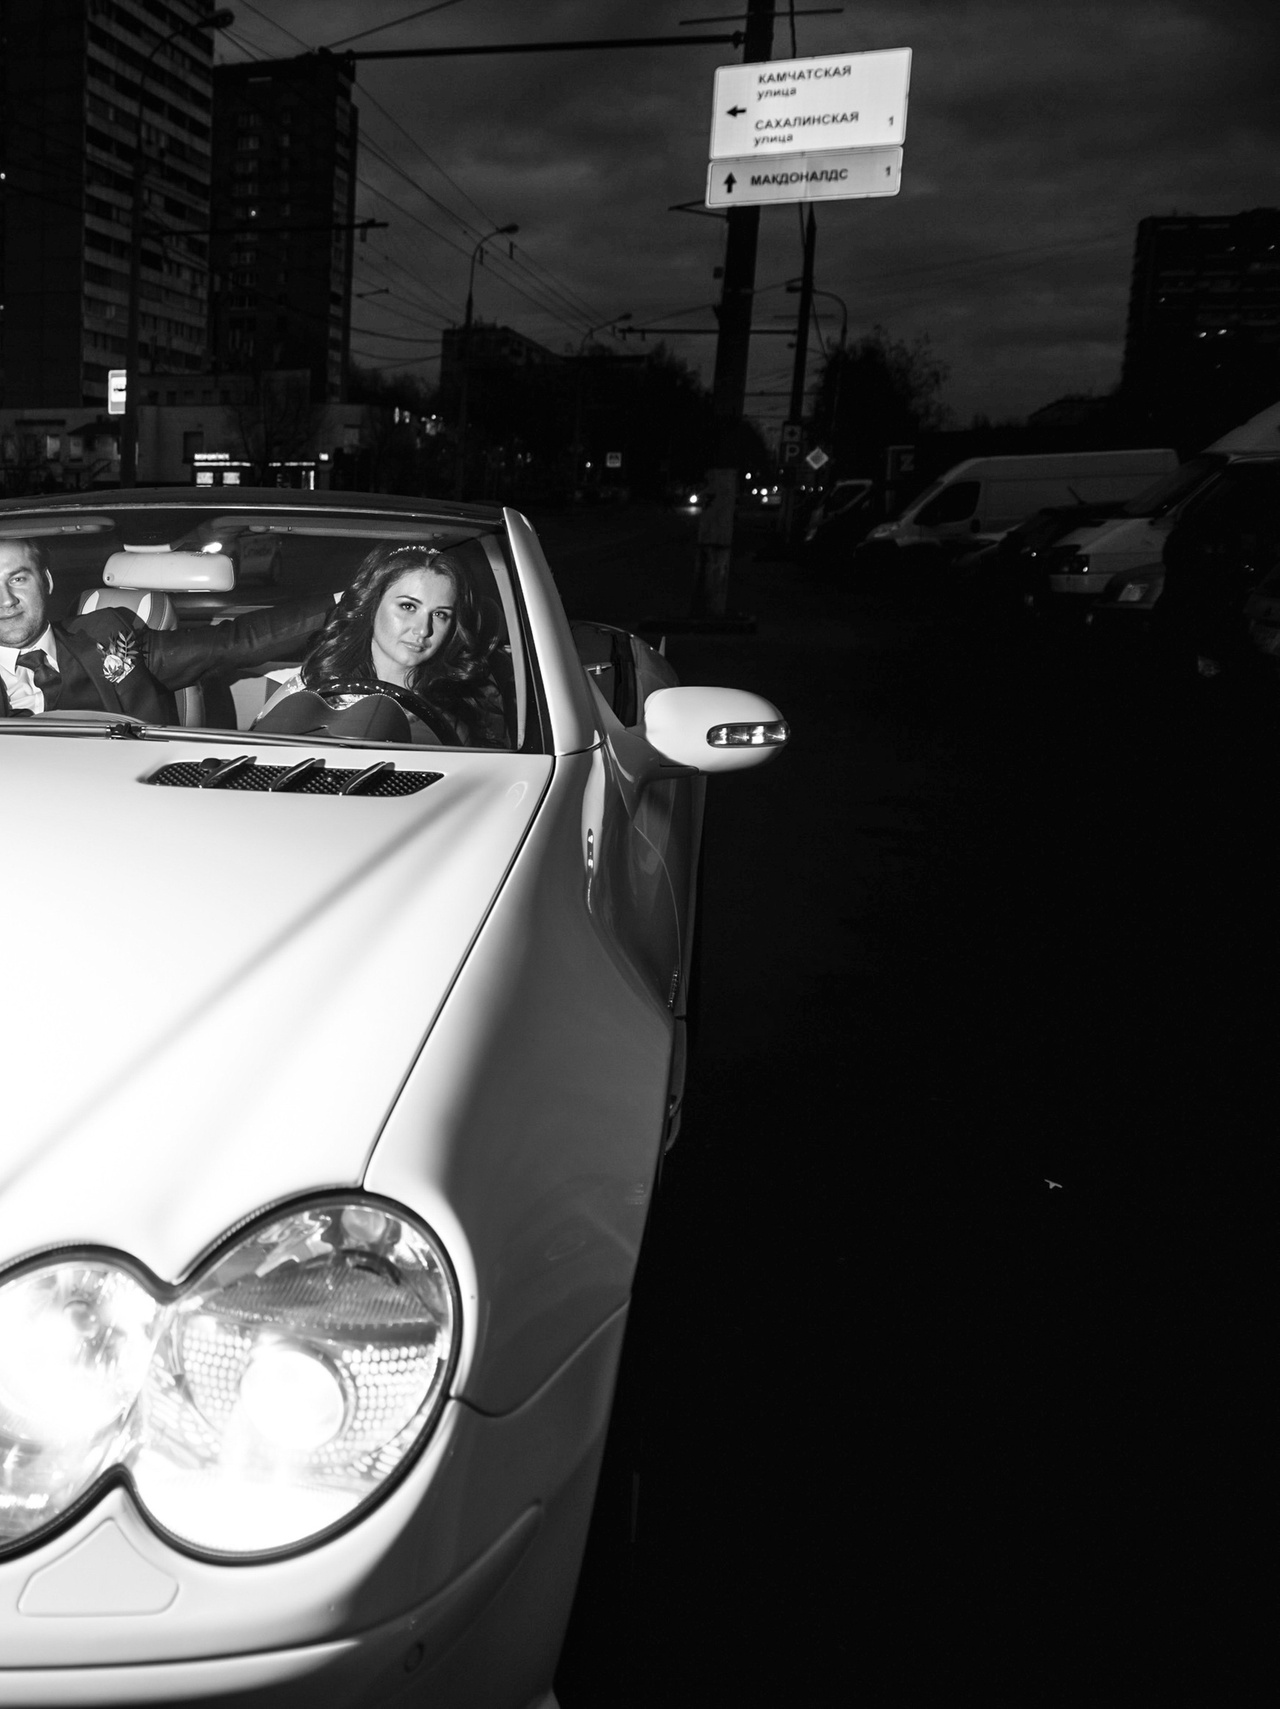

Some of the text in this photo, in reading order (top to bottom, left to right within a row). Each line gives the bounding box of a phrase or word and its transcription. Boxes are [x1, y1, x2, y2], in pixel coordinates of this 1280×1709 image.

[758, 65, 852, 84] КАМЧАТСКАЯ
[757, 87, 797, 100] улица
[755, 111, 895, 131] САХАЛИНСКАЯ 1
[753, 133, 793, 147] улица
[750, 168, 849, 187] МАКДОНАЛДС
